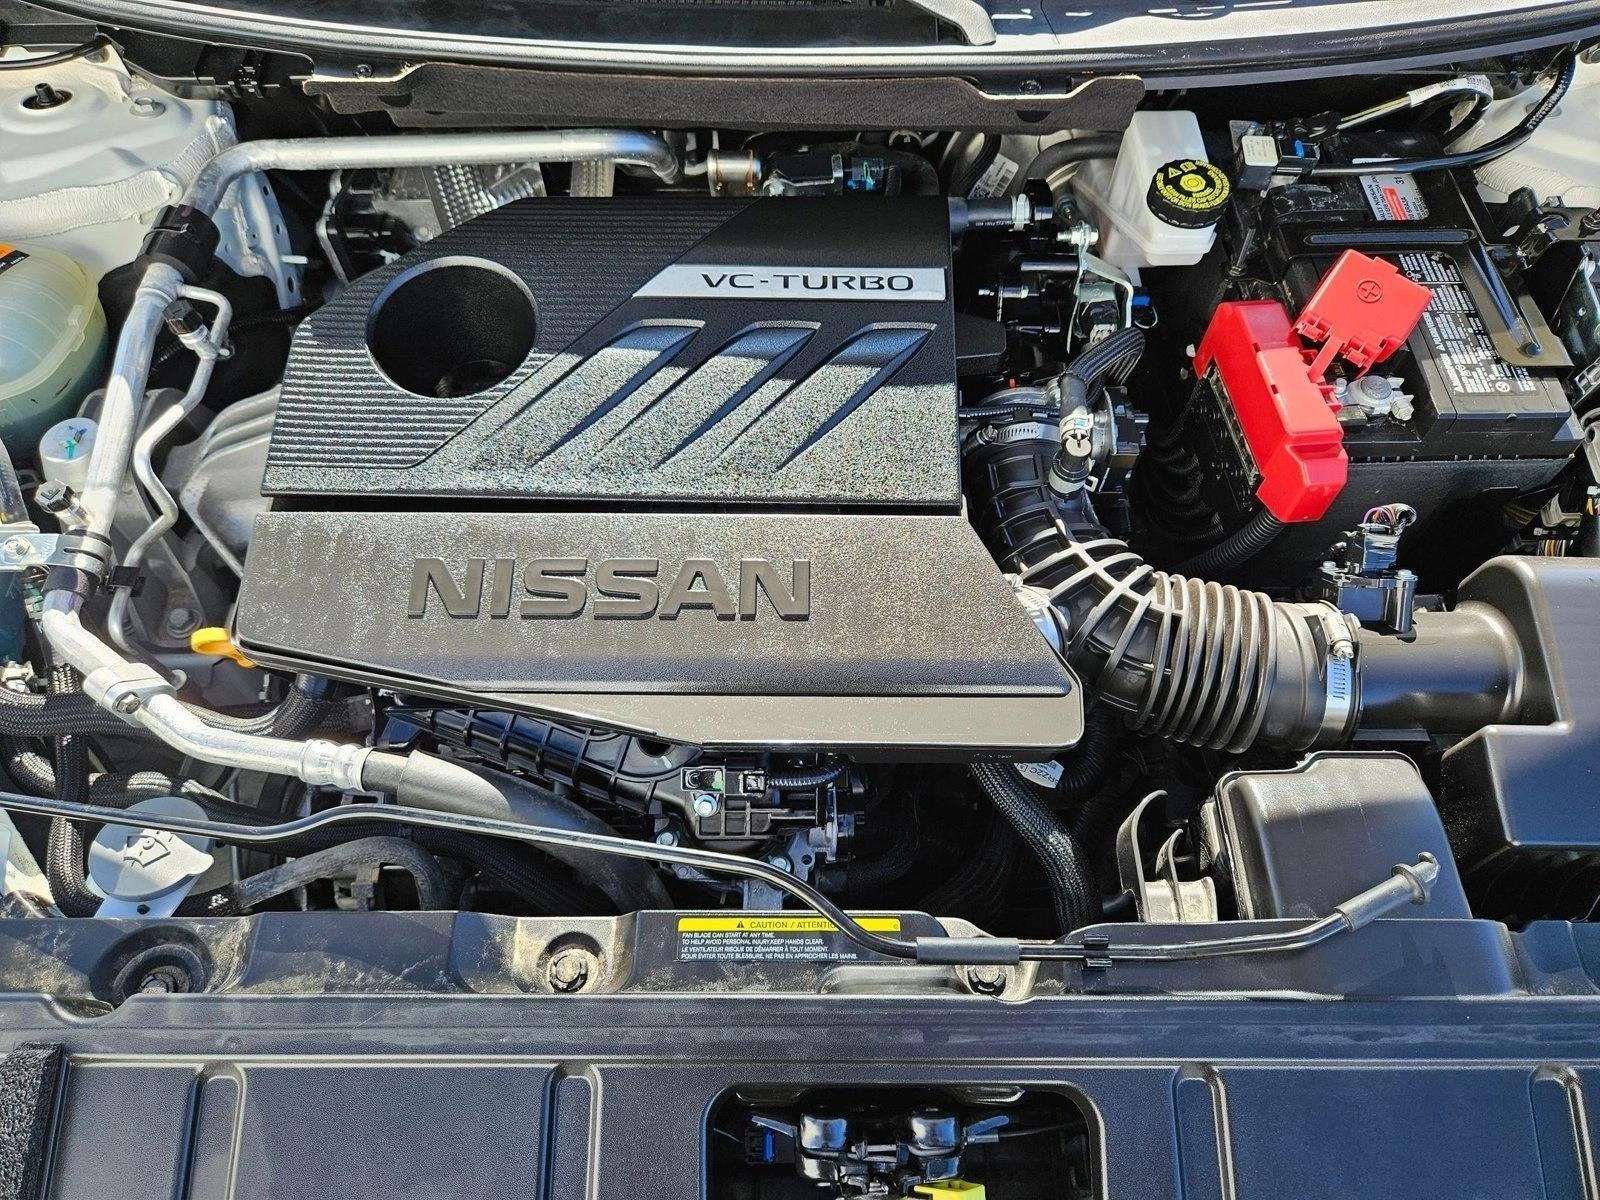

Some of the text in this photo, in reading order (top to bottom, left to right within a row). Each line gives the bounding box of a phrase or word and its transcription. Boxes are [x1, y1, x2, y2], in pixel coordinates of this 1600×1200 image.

[701, 273, 914, 291] VC-TURBO
[407, 557, 811, 621] NISSAN
[750, 921, 787, 929] CAUTION
